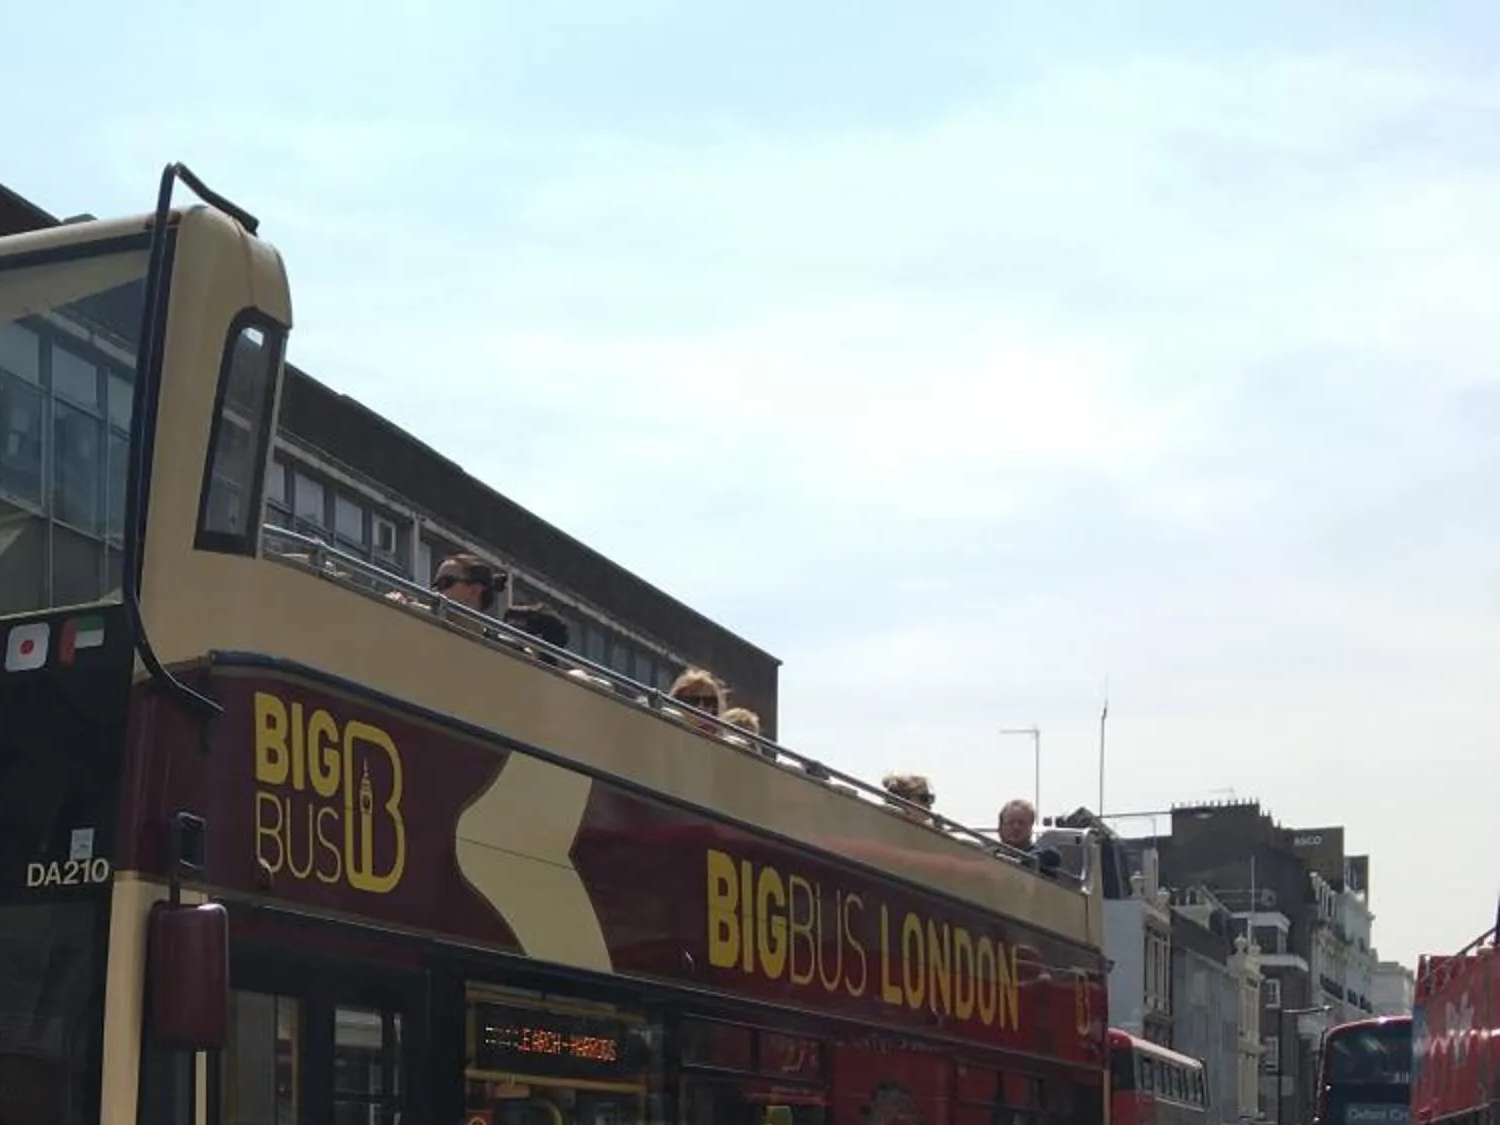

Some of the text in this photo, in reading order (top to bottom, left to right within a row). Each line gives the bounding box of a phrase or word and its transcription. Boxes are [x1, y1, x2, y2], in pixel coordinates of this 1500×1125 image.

[255, 691, 340, 797] BIG
[26, 857, 109, 888] DA210
[256, 791, 341, 884] BUS
[881, 904, 1018, 1032] LONDON
